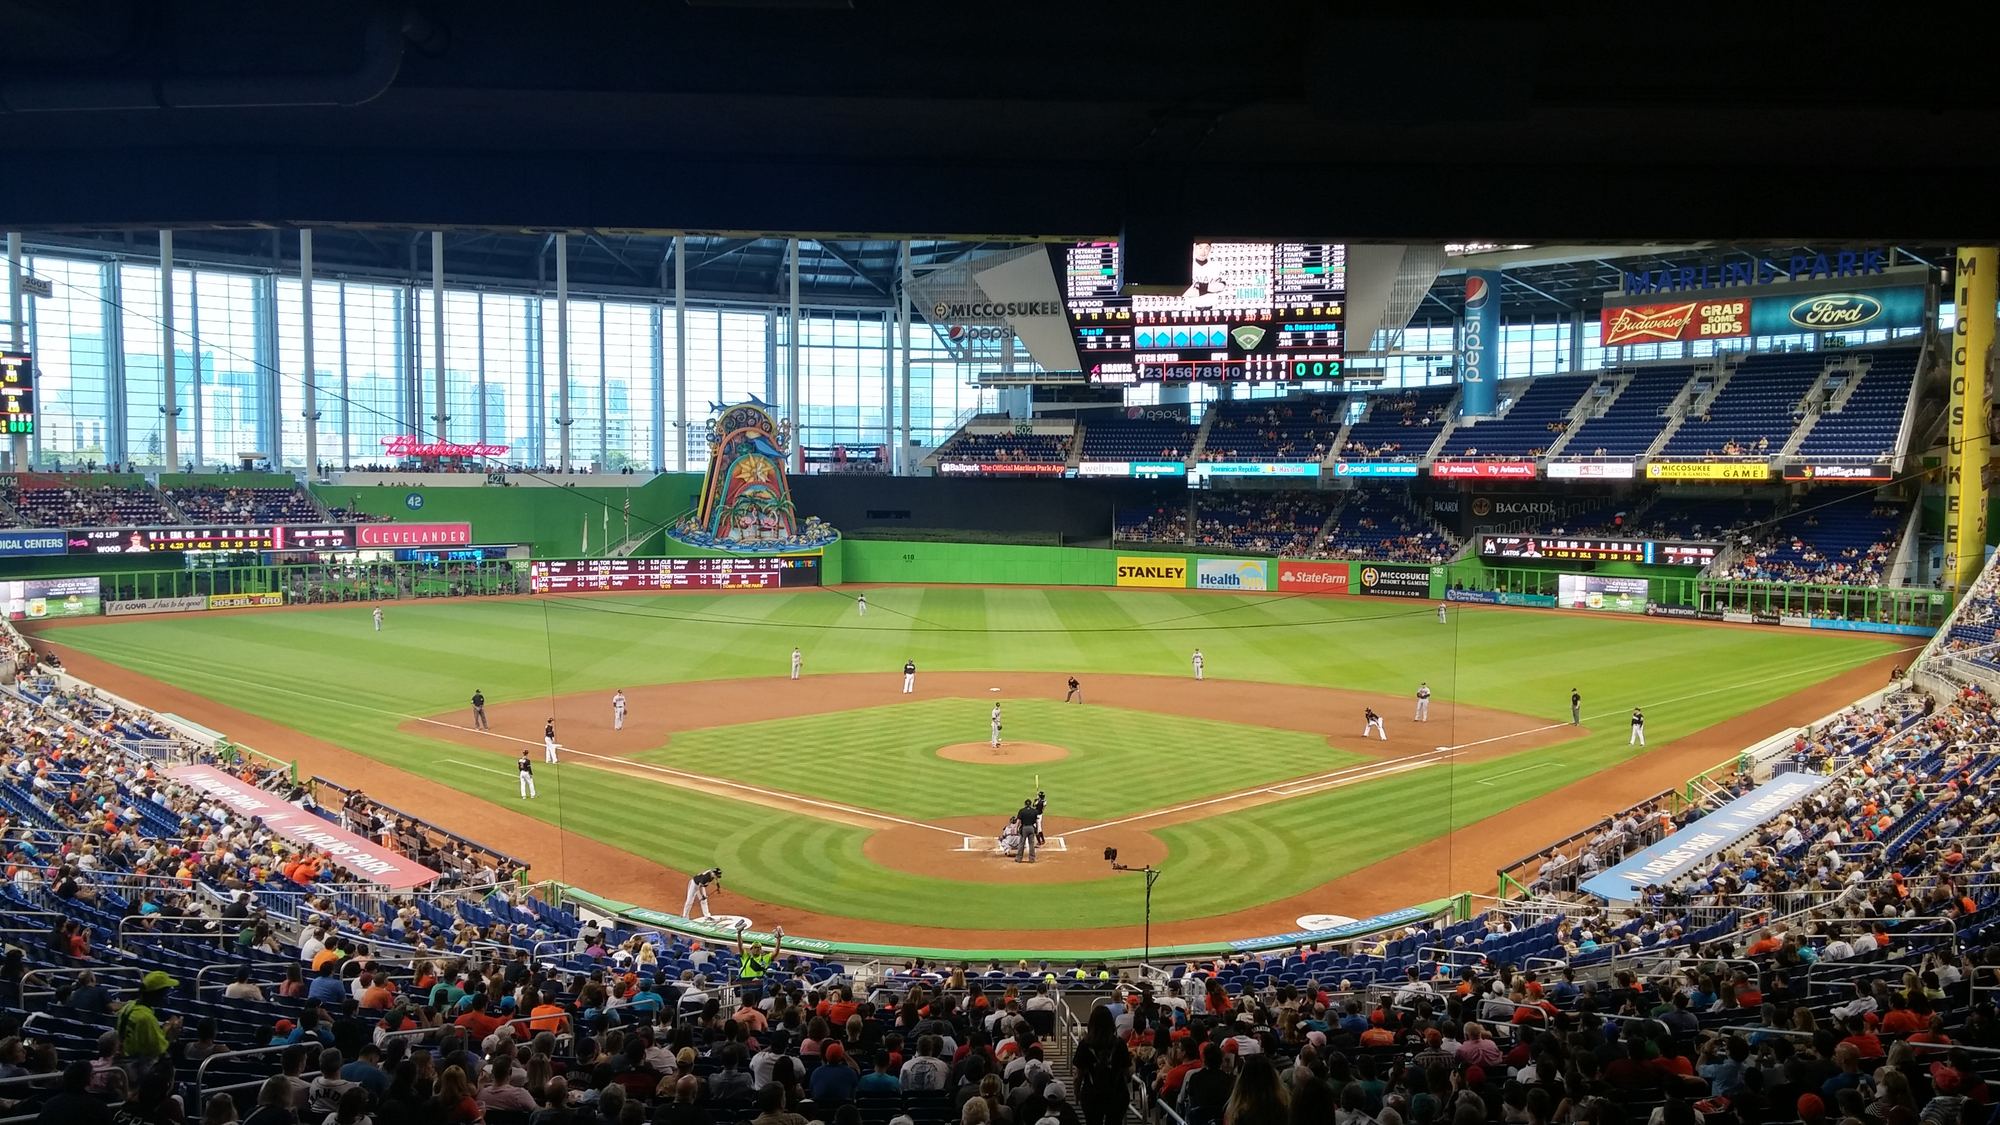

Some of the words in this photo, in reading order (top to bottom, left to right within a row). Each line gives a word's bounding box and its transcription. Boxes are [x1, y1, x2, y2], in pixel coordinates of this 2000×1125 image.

[1624, 262, 1774, 297] MARLINS
[1789, 249, 1885, 281] PARK
[1236, 287, 1265, 299] ICHIRO
[950, 302, 1059, 318] MICCOSUKEE
[1701, 303, 1743, 317] GRAB
[1806, 301, 1863, 325] Ford
[1610, 315, 1690, 334] Budweiser
[1708, 315, 1736, 323] SOME
[968, 325, 1014, 342] pepsi
[1700, 322, 1743, 335] BUDS
[1465, 313, 1483, 383] pepsi
[1824, 337, 1845, 349] 448
[1102, 364, 1132, 372] BRAVES
[1296, 363, 1306, 376] 0
[1313, 363, 1323, 376] 0
[1330, 362, 1339, 376] 2
[26, 422, 32, 432] 2
[1016, 425, 1032, 435] 502
[950, 463, 980, 472] Ballpark
[1052, 465, 1064, 473] App
[1238, 466, 1260, 474] Republic
[1350, 466, 1370, 474] pepsi
[1438, 466, 1448, 474] Fly
[1450, 466, 1472, 474] Avianca
[1488, 466, 1498, 474] Fly
[1500, 466, 1524, 474] Avianca
[1724, 469, 1764, 478] GAME!
[0, 476, 18, 488] 401
[489, 474, 504, 484] 427
[407, 496, 421, 507] 42
[362, 528, 465, 544] CLEVELANDER
[24, 538, 63, 549] CENTERS
[795, 560, 816, 568] METER
[1118, 566, 1184, 579] STANLEY
[1295, 572, 1346, 584] StateFarm
[1380, 572, 1430, 580] MICCOSUKEE
[1200, 573, 1240, 586] Health
[158, 600, 169, 608] has
[170, 600, 176, 608] to
[177, 600, 184, 608] be
[212, 600, 252, 608] 305-DEL
[260, 597, 280, 605] ORO
[283, 823, 359, 857] MARLINS
[349, 853, 400, 876] PARK
[1620, 846, 1698, 885] MARLINS
[1690, 832, 1726, 851] PARK
[1380, 908, 1421, 921] RICOH
[1341, 918, 1378, 932] RICOH
[1288, 928, 1339, 940] RICOH
[1231, 936, 1282, 948] RICOH
